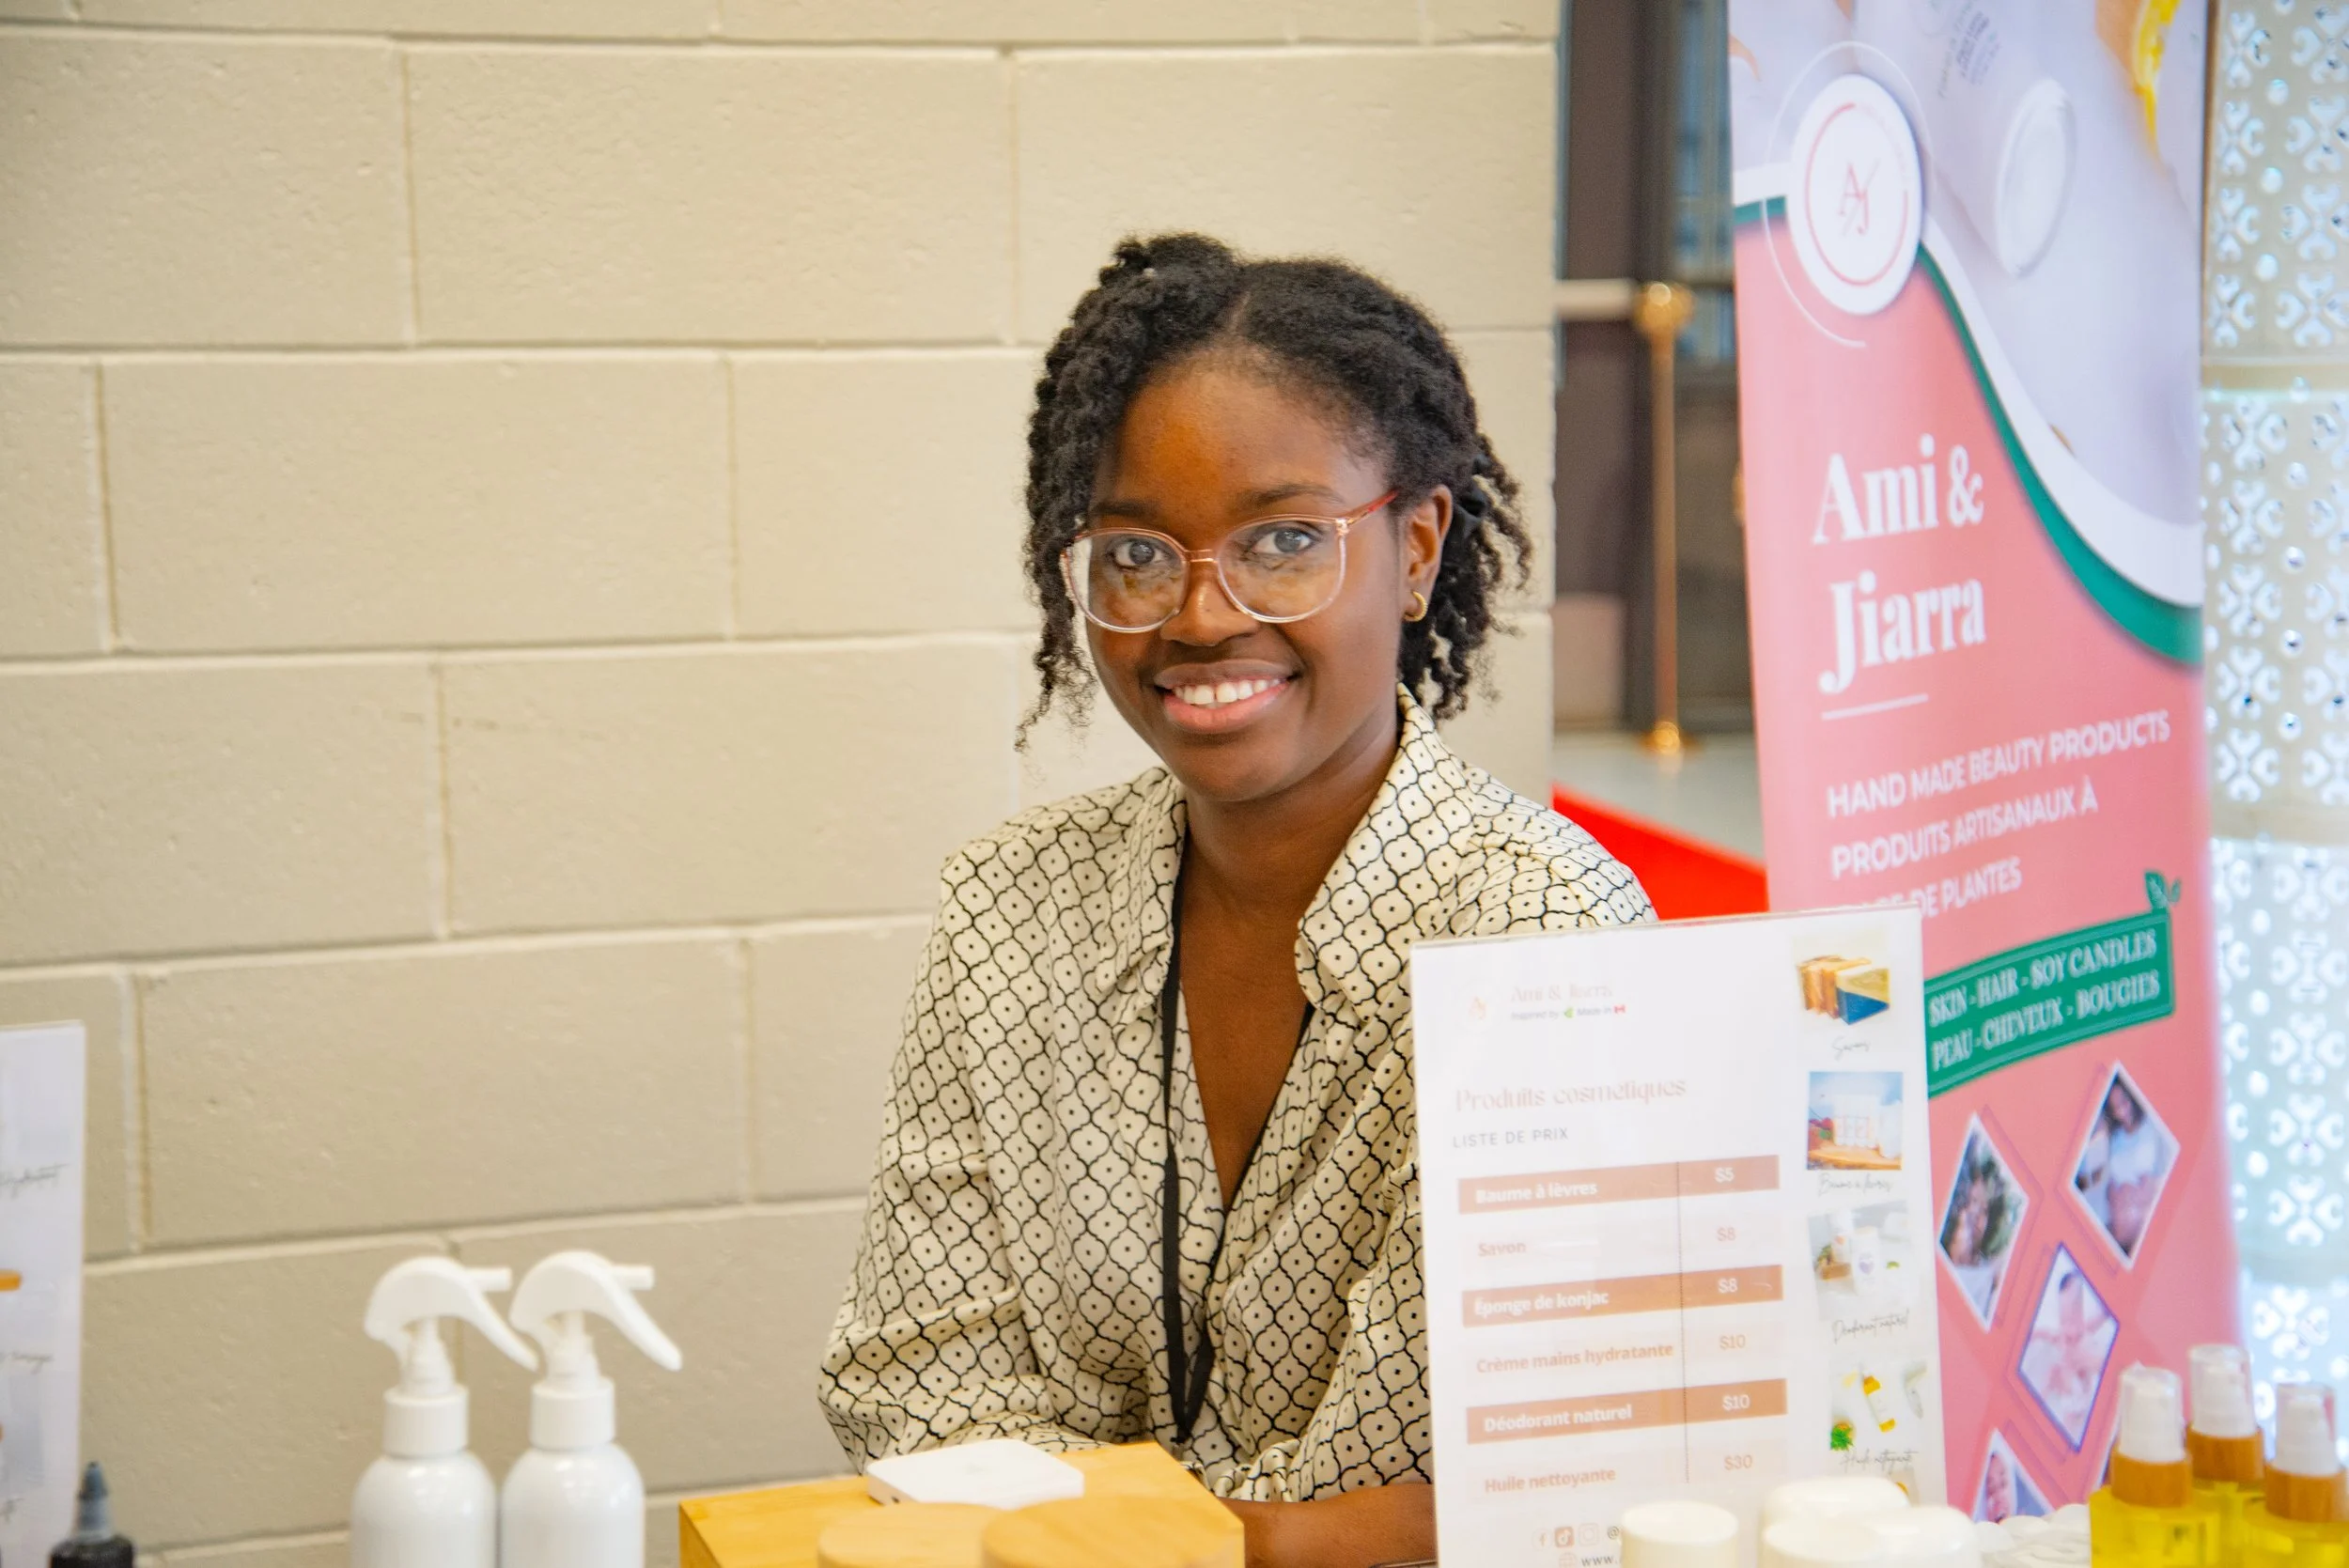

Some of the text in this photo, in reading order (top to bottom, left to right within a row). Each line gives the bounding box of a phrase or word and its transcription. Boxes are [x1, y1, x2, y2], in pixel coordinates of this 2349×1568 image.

[1812, 432, 1983, 545] Ami &
[1818, 569, 1986, 694] Jiarra
[1827, 710, 2170, 819] HAND MADE BEAUTY PRODUCTS
[1831, 824, 1952, 879] PRODUITS
[1953, 786, 2077, 848] ARTISANAUX
[1941, 857, 2023, 911] PLANTES
[1929, 986, 1968, 1028] SKIN
[1977, 967, 2019, 1008] HAIR
[2030, 953, 2067, 990] SOY
[2068, 928, 2157, 978] CANDLES
[1932, 1029, 1974, 1072] PEAU
[1982, 997, 2063, 1050] CHEVEUX
[2076, 969, 2160, 1019] BOUGIES
[1455, 1087, 1546, 1112] Produits
[1453, 1126, 1568, 1149] LISTE DE PRIX
[1475, 1186, 1532, 1204] Baume
[1548, 1181, 1597, 1198] lèvres
[1715, 1166, 1735, 1183] $5
[1477, 1226, 1736, 1257] Savon $8
[1474, 1278, 1738, 1319] Éponge de konjac $8
[1476, 1334, 1747, 1374] Crème mains hydratante $10
[1485, 1394, 1750, 1433] Déodorant naturel $10
[1485, 1454, 1753, 1494] Huile nettoyante $30
